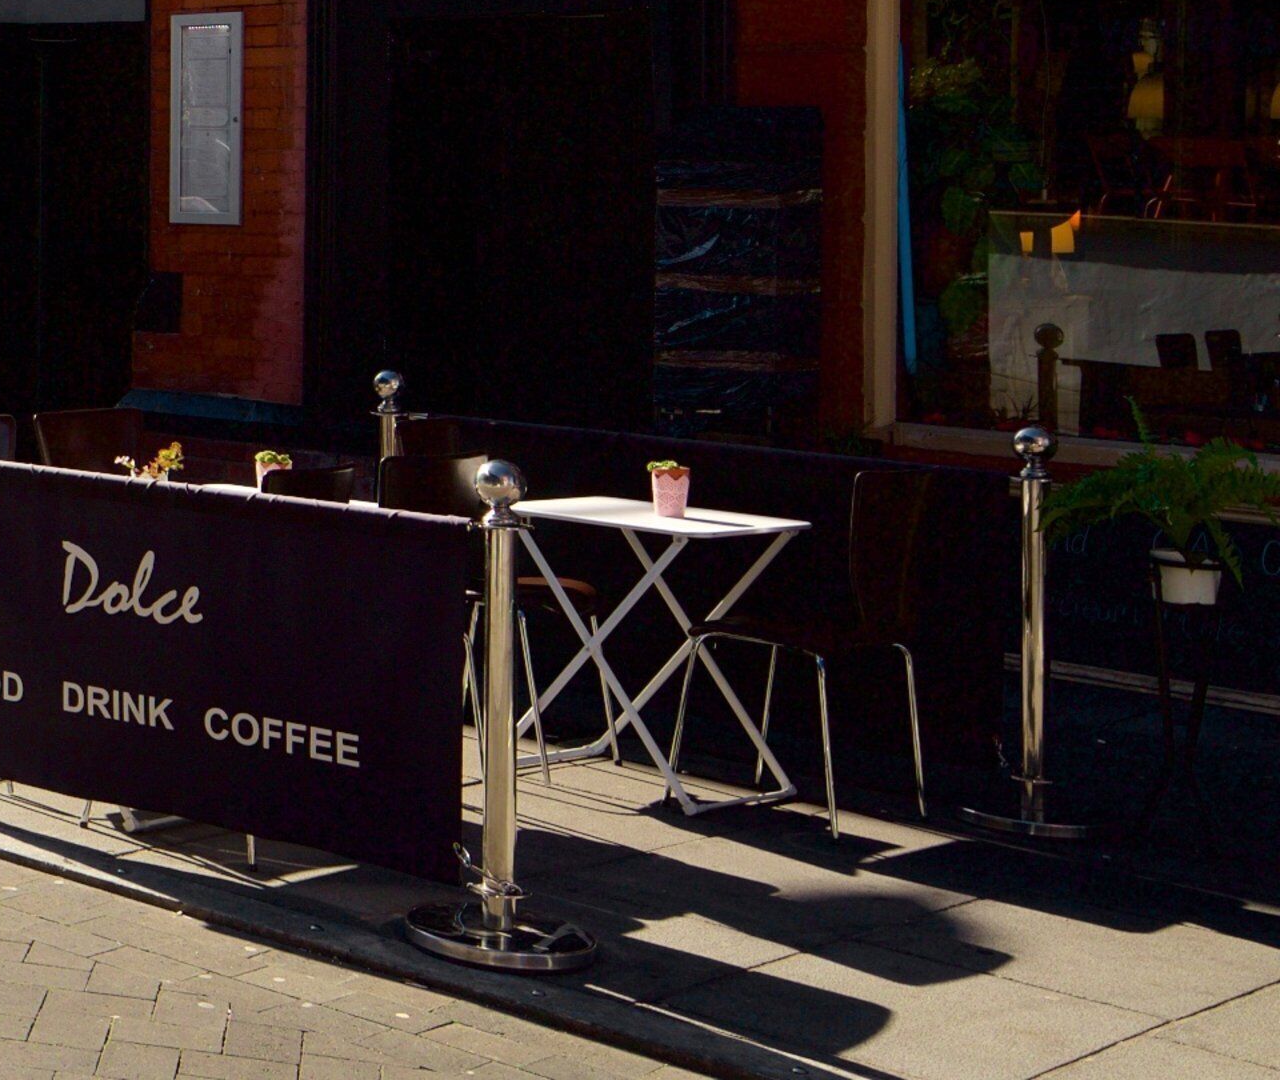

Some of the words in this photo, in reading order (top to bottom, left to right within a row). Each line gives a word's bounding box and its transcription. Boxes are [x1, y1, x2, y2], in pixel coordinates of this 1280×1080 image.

[61, 540, 203, 624] Dolce
[62, 680, 175, 730] DRINK
[204, 707, 360, 768] COFFEE
